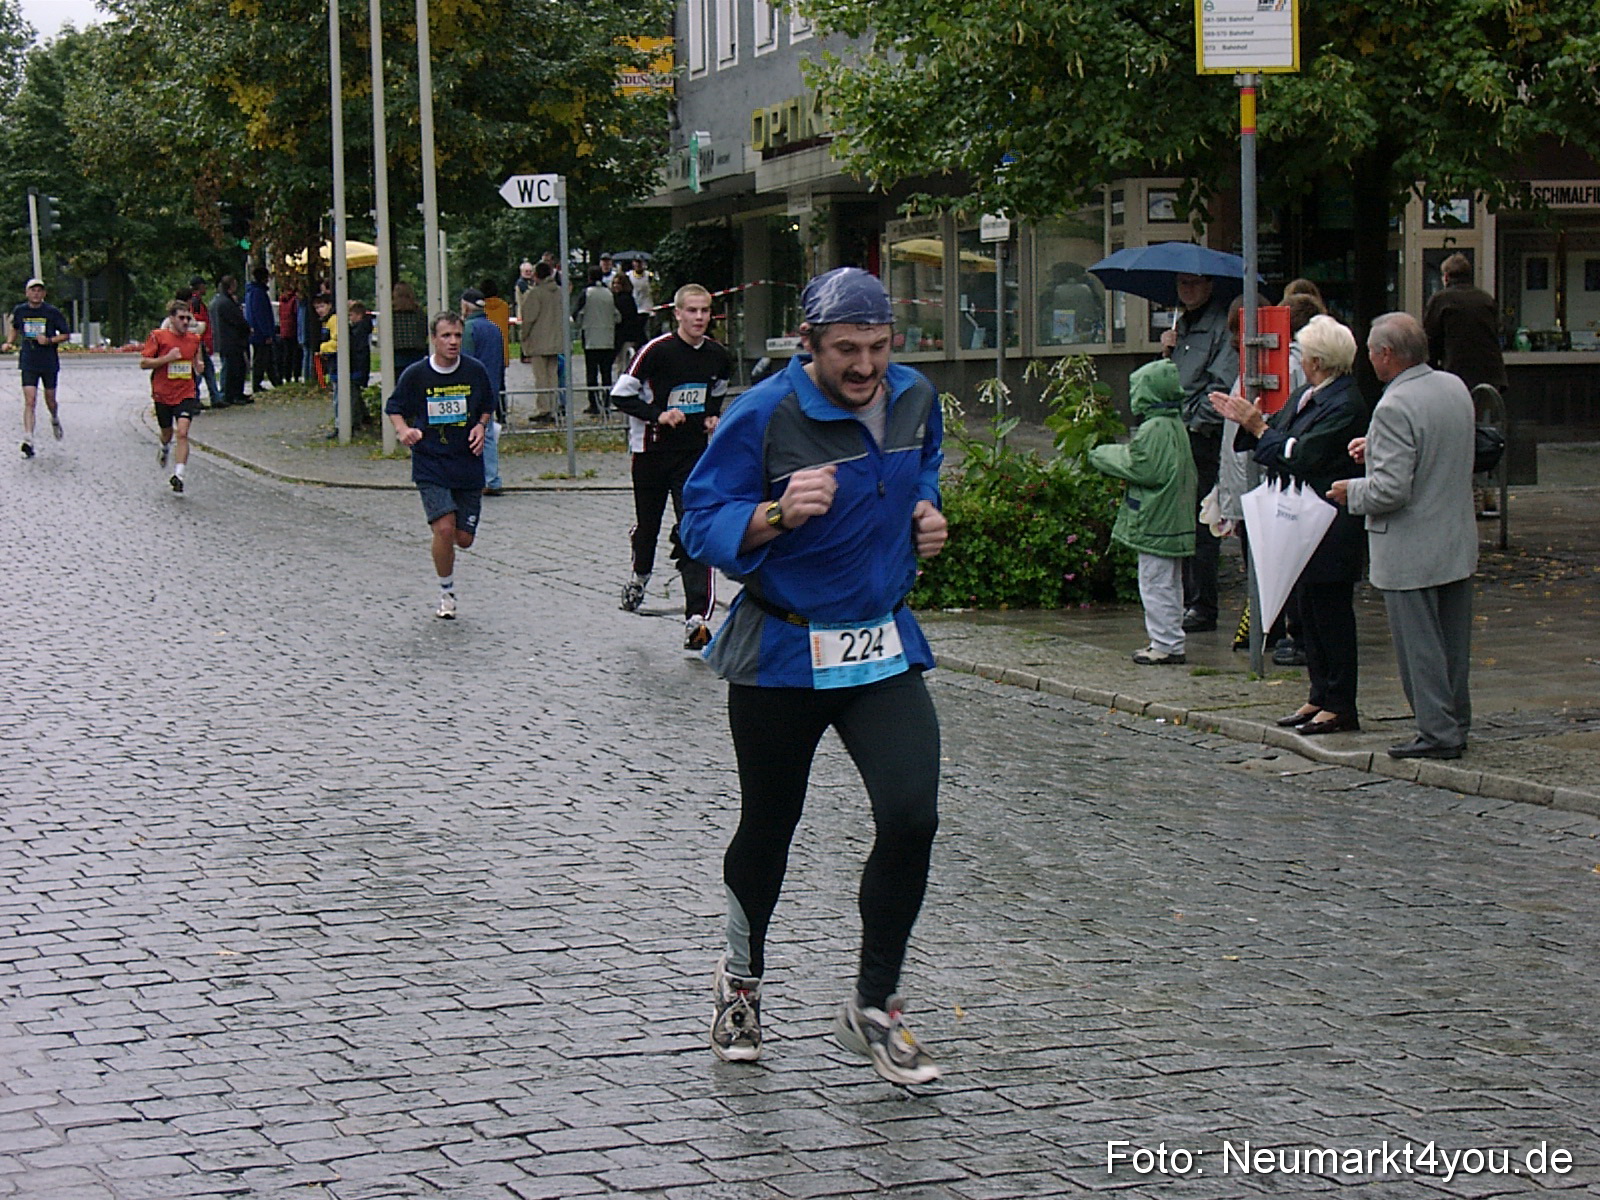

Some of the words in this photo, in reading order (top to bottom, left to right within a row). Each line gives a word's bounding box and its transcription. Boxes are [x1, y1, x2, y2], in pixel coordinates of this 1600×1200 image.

[1229, 15, 1255, 23] Bahnhof
[1222, 43, 1248, 51] Bahnhof
[517, 179, 551, 203] WC
[678, 390, 699, 405] 402
[438, 401, 461, 414] 383
[840, 627, 884, 662] 224
